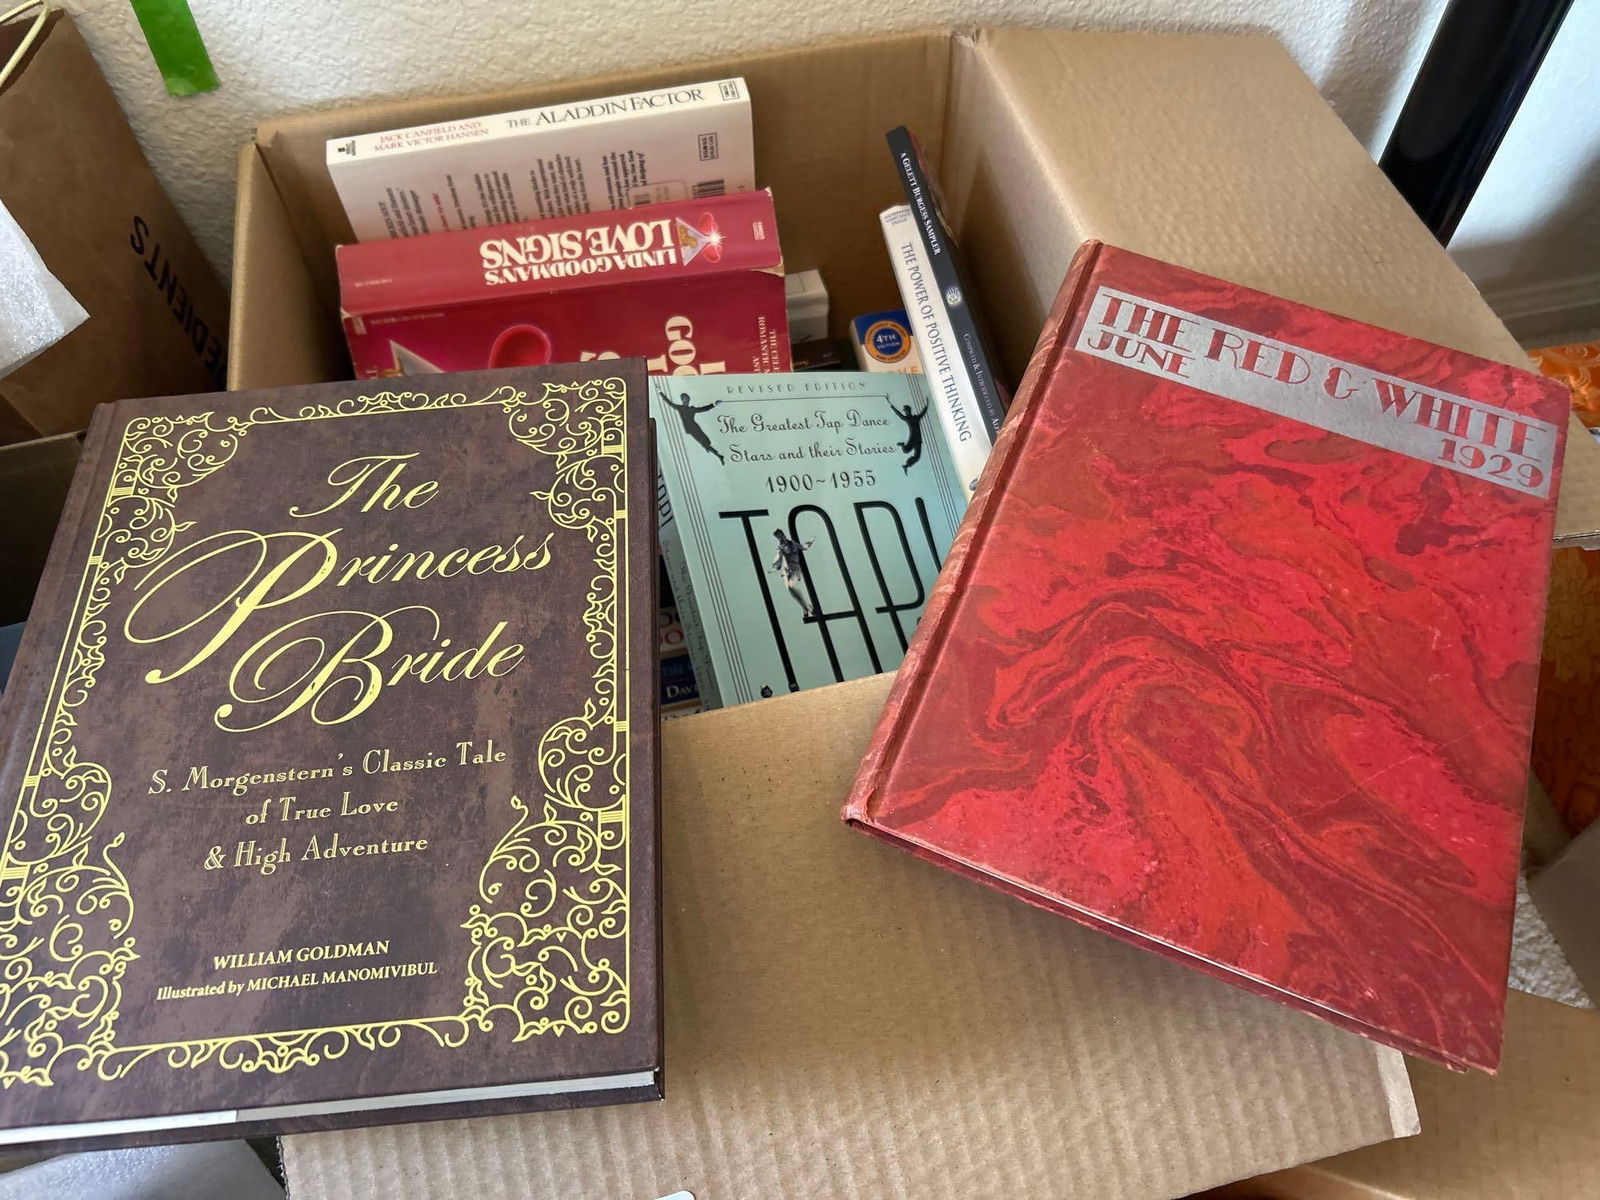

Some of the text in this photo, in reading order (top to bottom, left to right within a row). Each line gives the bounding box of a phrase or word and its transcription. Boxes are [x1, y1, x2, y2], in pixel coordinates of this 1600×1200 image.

[507, 118, 531, 129] THE
[535, 99, 628, 126] ALADDIN
[631, 88, 705, 111] FACTOR
[374, 128, 489, 151] MARK VICTOR HANSEN
[380, 121, 481, 143] JACK CANFIELD AND
[901, 156, 918, 186] GELETT
[911, 186, 930, 220] BURGESS
[923, 218, 942, 255] SAMPLER
[479, 219, 674, 270] LOVE SIGNS
[484, 248, 677, 286] LINDA GOODMAN'S
[900, 241, 972, 442] THE POWER OF POSITIVE THINKING
[972, 362, 981, 370] &
[1098, 292, 1550, 462] THE RED & WHITE
[727, 380, 868, 395] REVISED EDITION
[717, 408, 889, 434] The Greatest Tap Dance
[1087, 328, 1545, 489] JUNE 1929
[729, 437, 896, 463] Stars and their Stories
[289, 453, 440, 518] The
[123, 528, 555, 684] Princess
[214, 605, 526, 733] Bride
[148, 740, 507, 796] S. Morgenstern's Classic Tale
[245, 792, 400, 825] of True Love
[204, 833, 429, 875] & High Adventure
[213, 940, 390, 970] WILLIAM GOLDMAN
[156, 962, 438, 1001] Illustrated by MICHAEL MANOMIVIBUL
